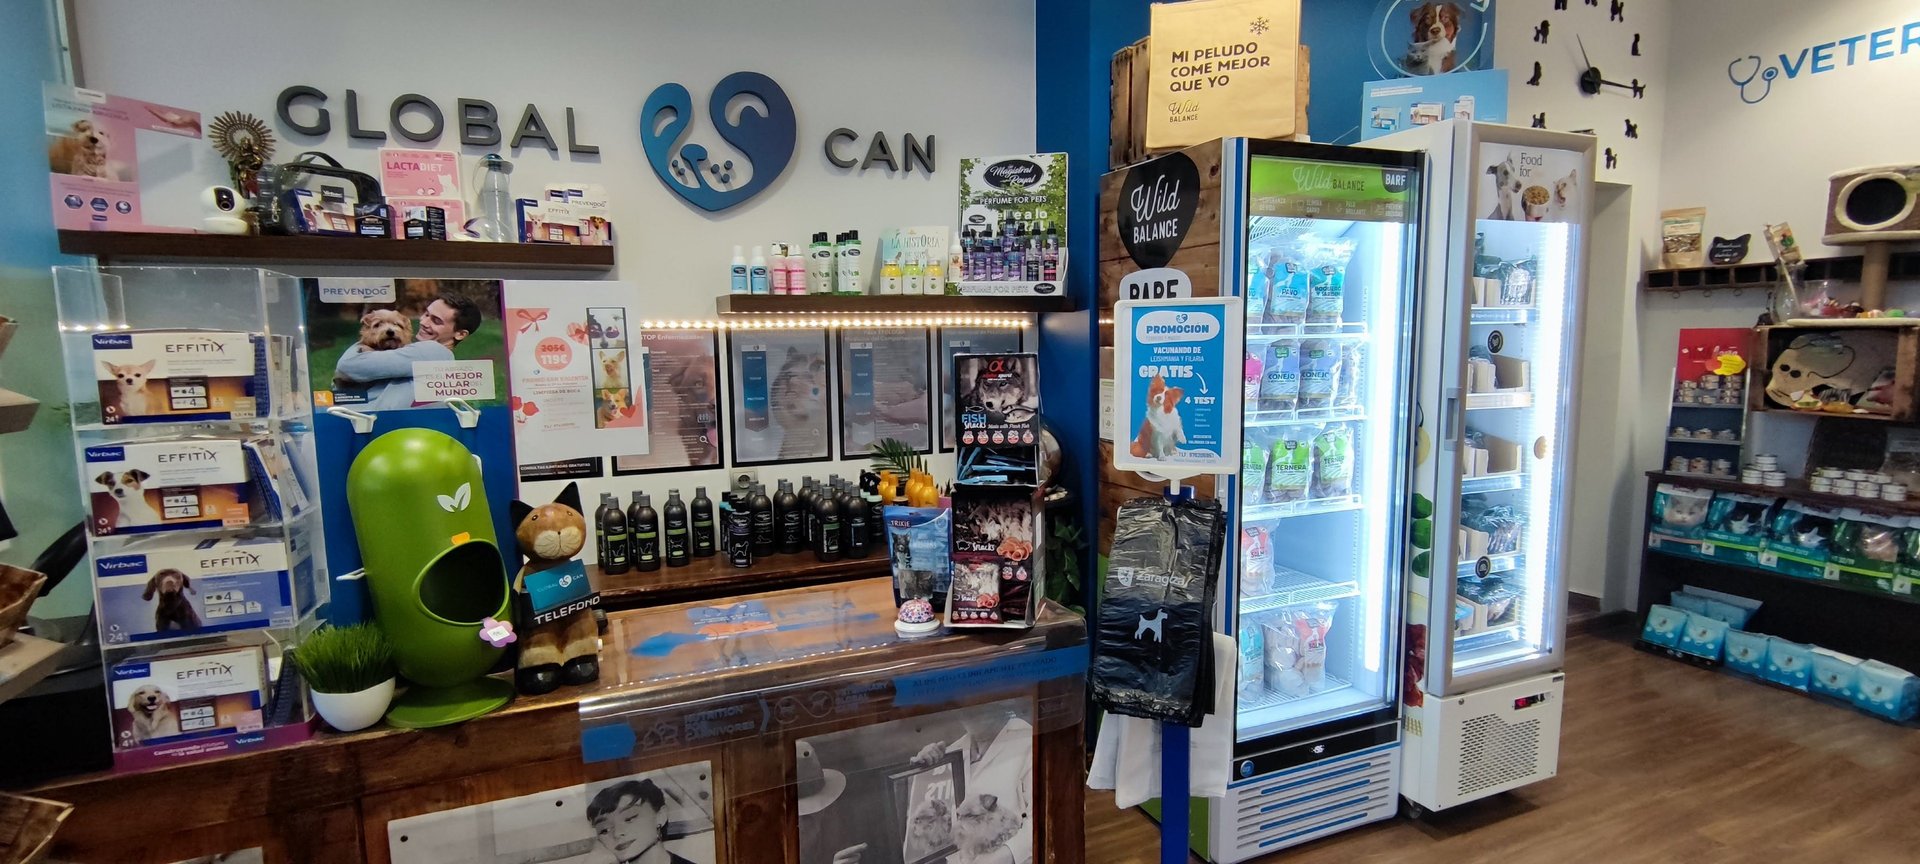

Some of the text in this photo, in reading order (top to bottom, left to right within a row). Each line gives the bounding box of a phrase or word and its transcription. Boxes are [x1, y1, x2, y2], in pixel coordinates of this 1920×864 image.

[1171, 42, 1258, 63] MI PELUDO
[1170, 56, 1270, 78] COME MEJOR
[1170, 75, 1229, 93] QUE YO
[1168, 99, 1200, 115] Wild
[276, 85, 600, 154] GLOBAL
[1169, 114, 1198, 123] BALANCE
[824, 127, 936, 173] CAN
[1520, 152, 1543, 166] Food
[386, 161, 444, 172] LACTADIET
[990, 164, 1035, 178] Magistral
[1519, 167, 1531, 178] for
[1009, 174, 1037, 187] Royal
[1293, 164, 1406, 192] Wild BALANCE BARF
[1130, 174, 1180, 223] Wild
[1133, 218, 1178, 244] BALANCE
[323, 286, 388, 297] PREVENDOG
[994, 284, 1009, 293] FOR
[1011, 284, 1029, 293] PETS
[1281, 288, 1298, 296] PAVO
[1146, 322, 1210, 335] PROMOCIÓN
[94, 338, 130, 346] Virbac
[165, 341, 225, 354] EFFITIX
[1153, 346, 1191, 354] VACUNANDO
[540, 354, 568, 364] 119€
[445, 372, 483, 380] MEJOR
[1138, 365, 1194, 378] GRATIS
[427, 380, 470, 388] COLLAR
[435, 388, 477, 396] MUNDO
[1184, 396, 1216, 405] 4 TEST
[961, 413, 987, 423] FISH
[87, 450, 122, 458] Virbac
[158, 449, 217, 463] EFFITIX
[890, 519, 910, 528] TRIXIE
[972, 542, 995, 551] Snacks
[99, 560, 144, 570] Virbac
[200, 553, 261, 569] EFFITIX
[1136, 569, 1186, 587] Zaragoza
[533, 595, 600, 625] TELEFONO
[115, 667, 148, 676] Virbac
[176, 664, 233, 681] EFFITIX
[235, 735, 265, 745] Virbac
